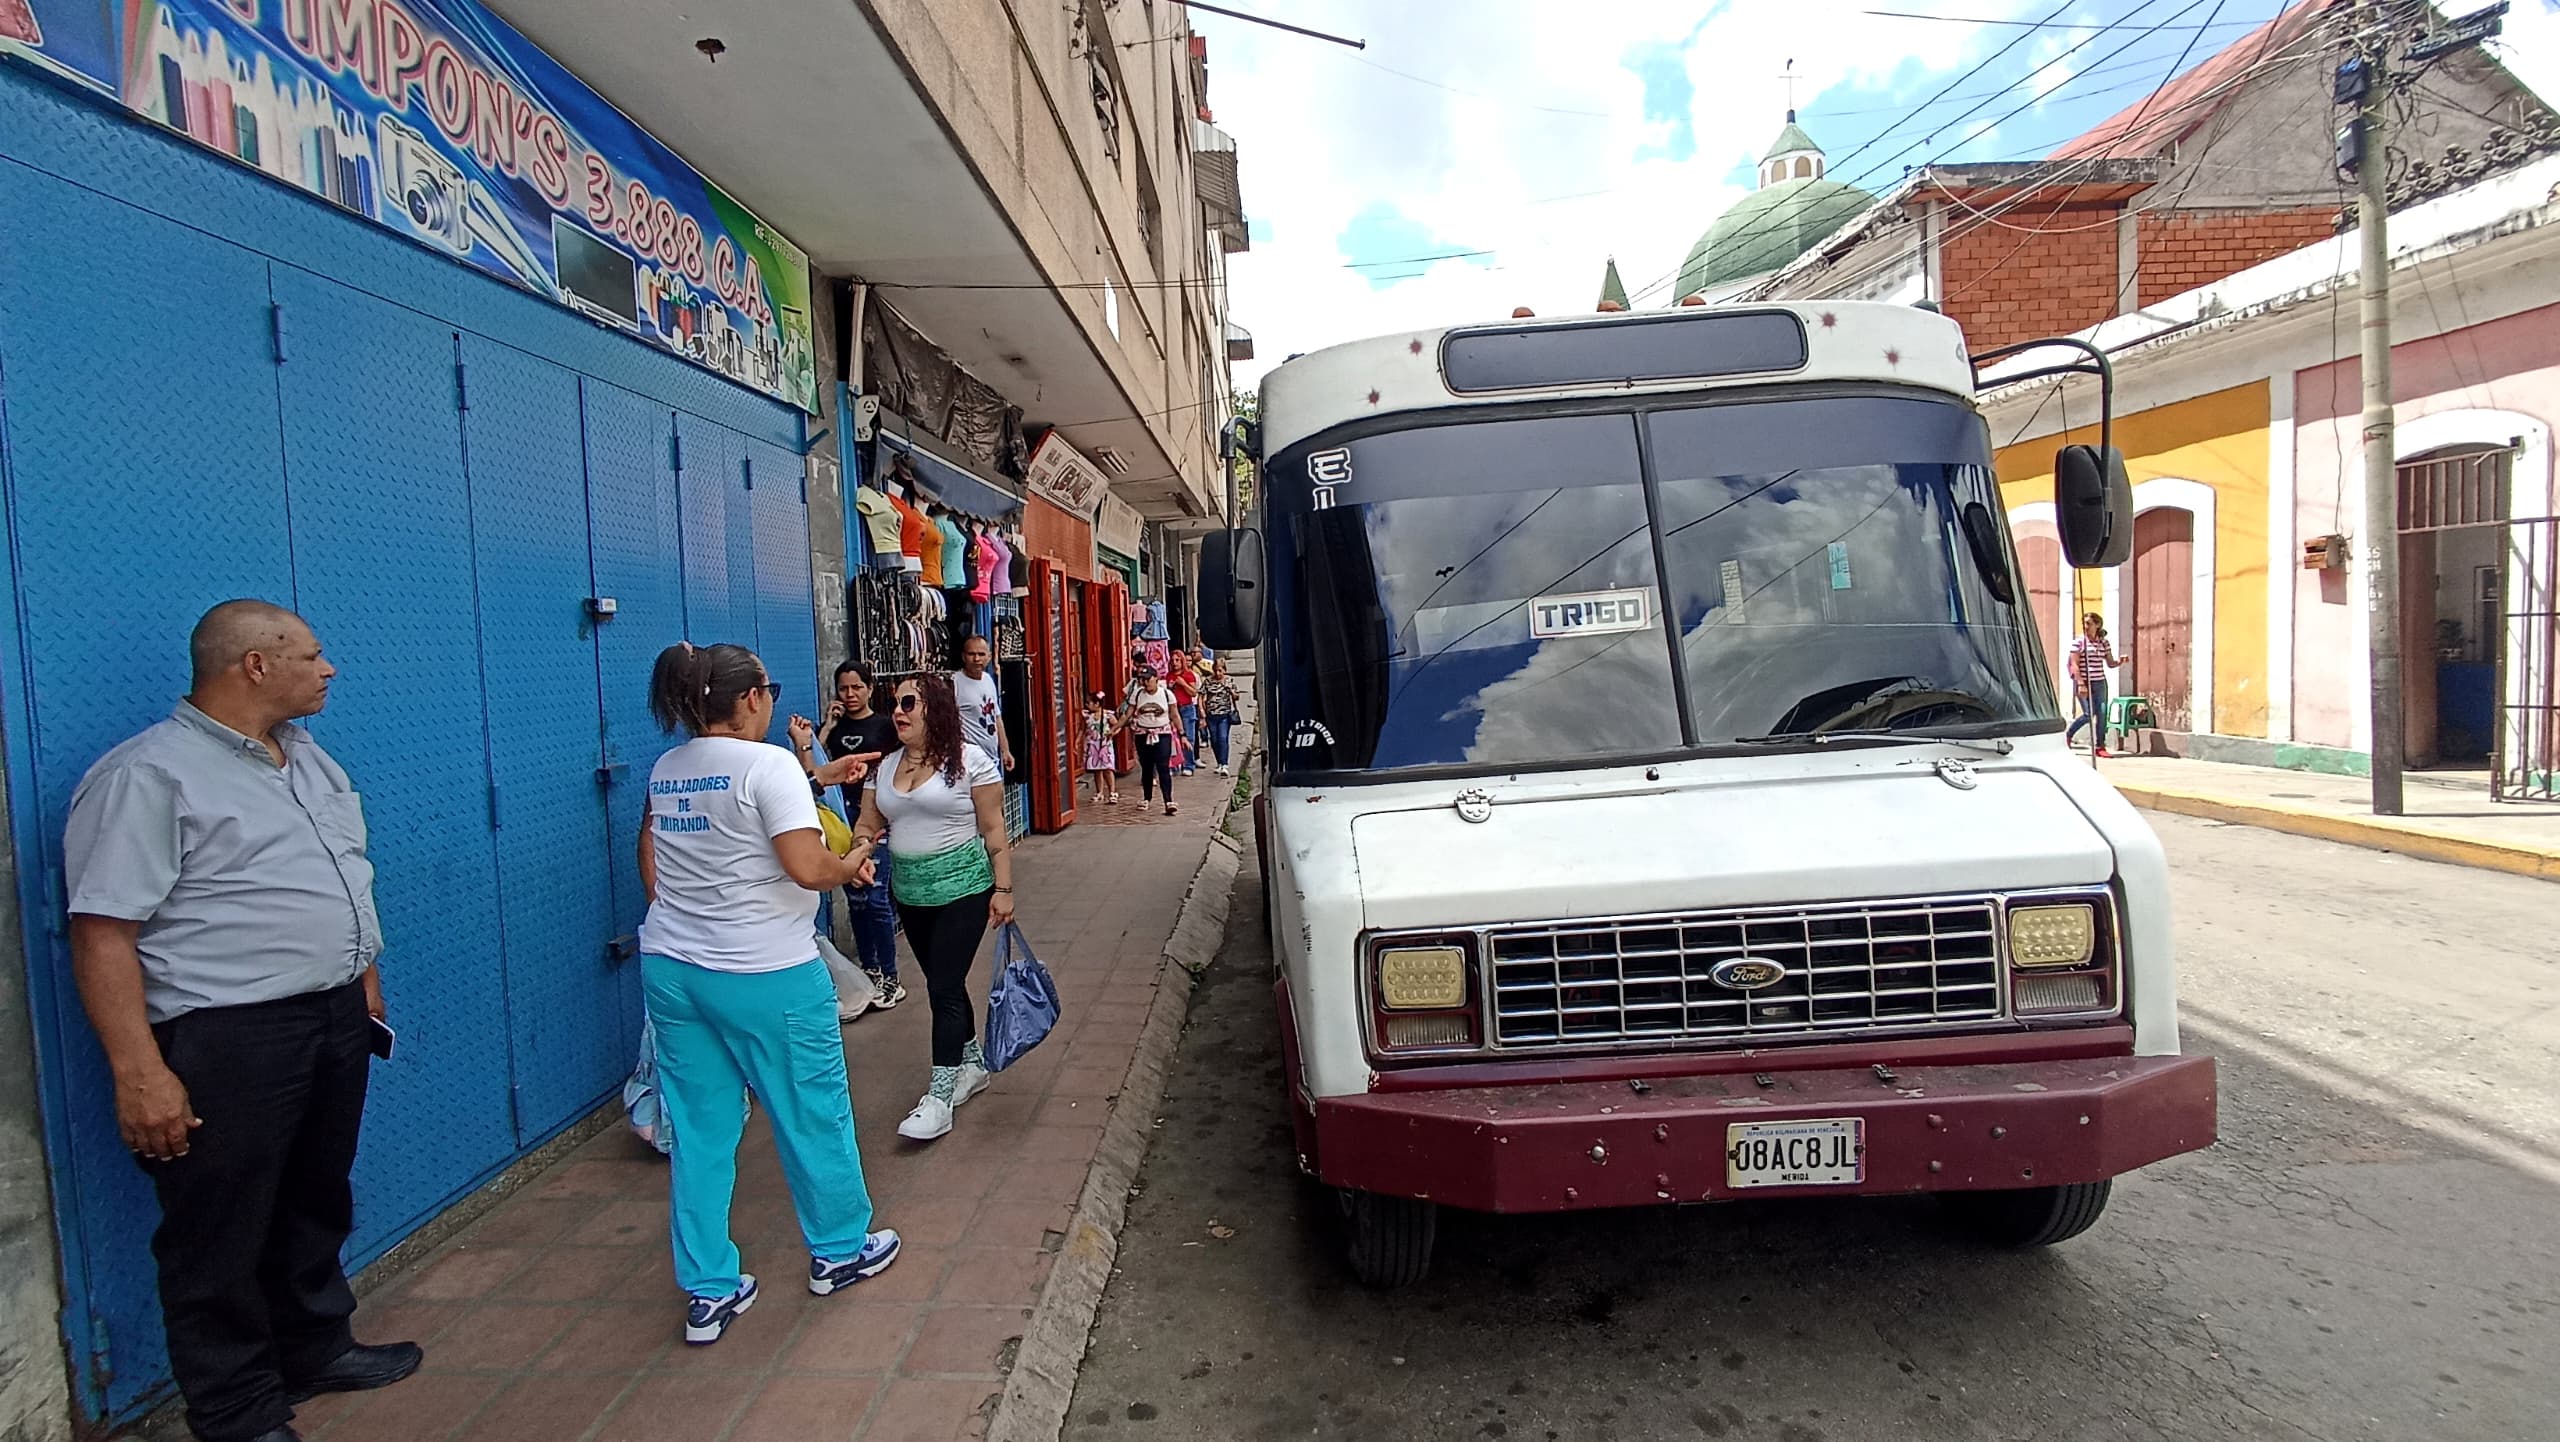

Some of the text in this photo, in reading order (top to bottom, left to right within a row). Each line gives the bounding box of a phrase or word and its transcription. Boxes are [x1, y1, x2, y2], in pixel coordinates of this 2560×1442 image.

[585, 154, 704, 284] 3.888
[713, 236, 771, 324] C.A.
[1538, 599, 1641, 628] TRIGO
[650, 775, 731, 795] TRABAJADORES
[678, 798, 691, 813] DE
[660, 815, 710, 832] MIRANDA
[1730, 966, 1767, 981] Ford
[1781, 1173, 1809, 1181] MERIDA
